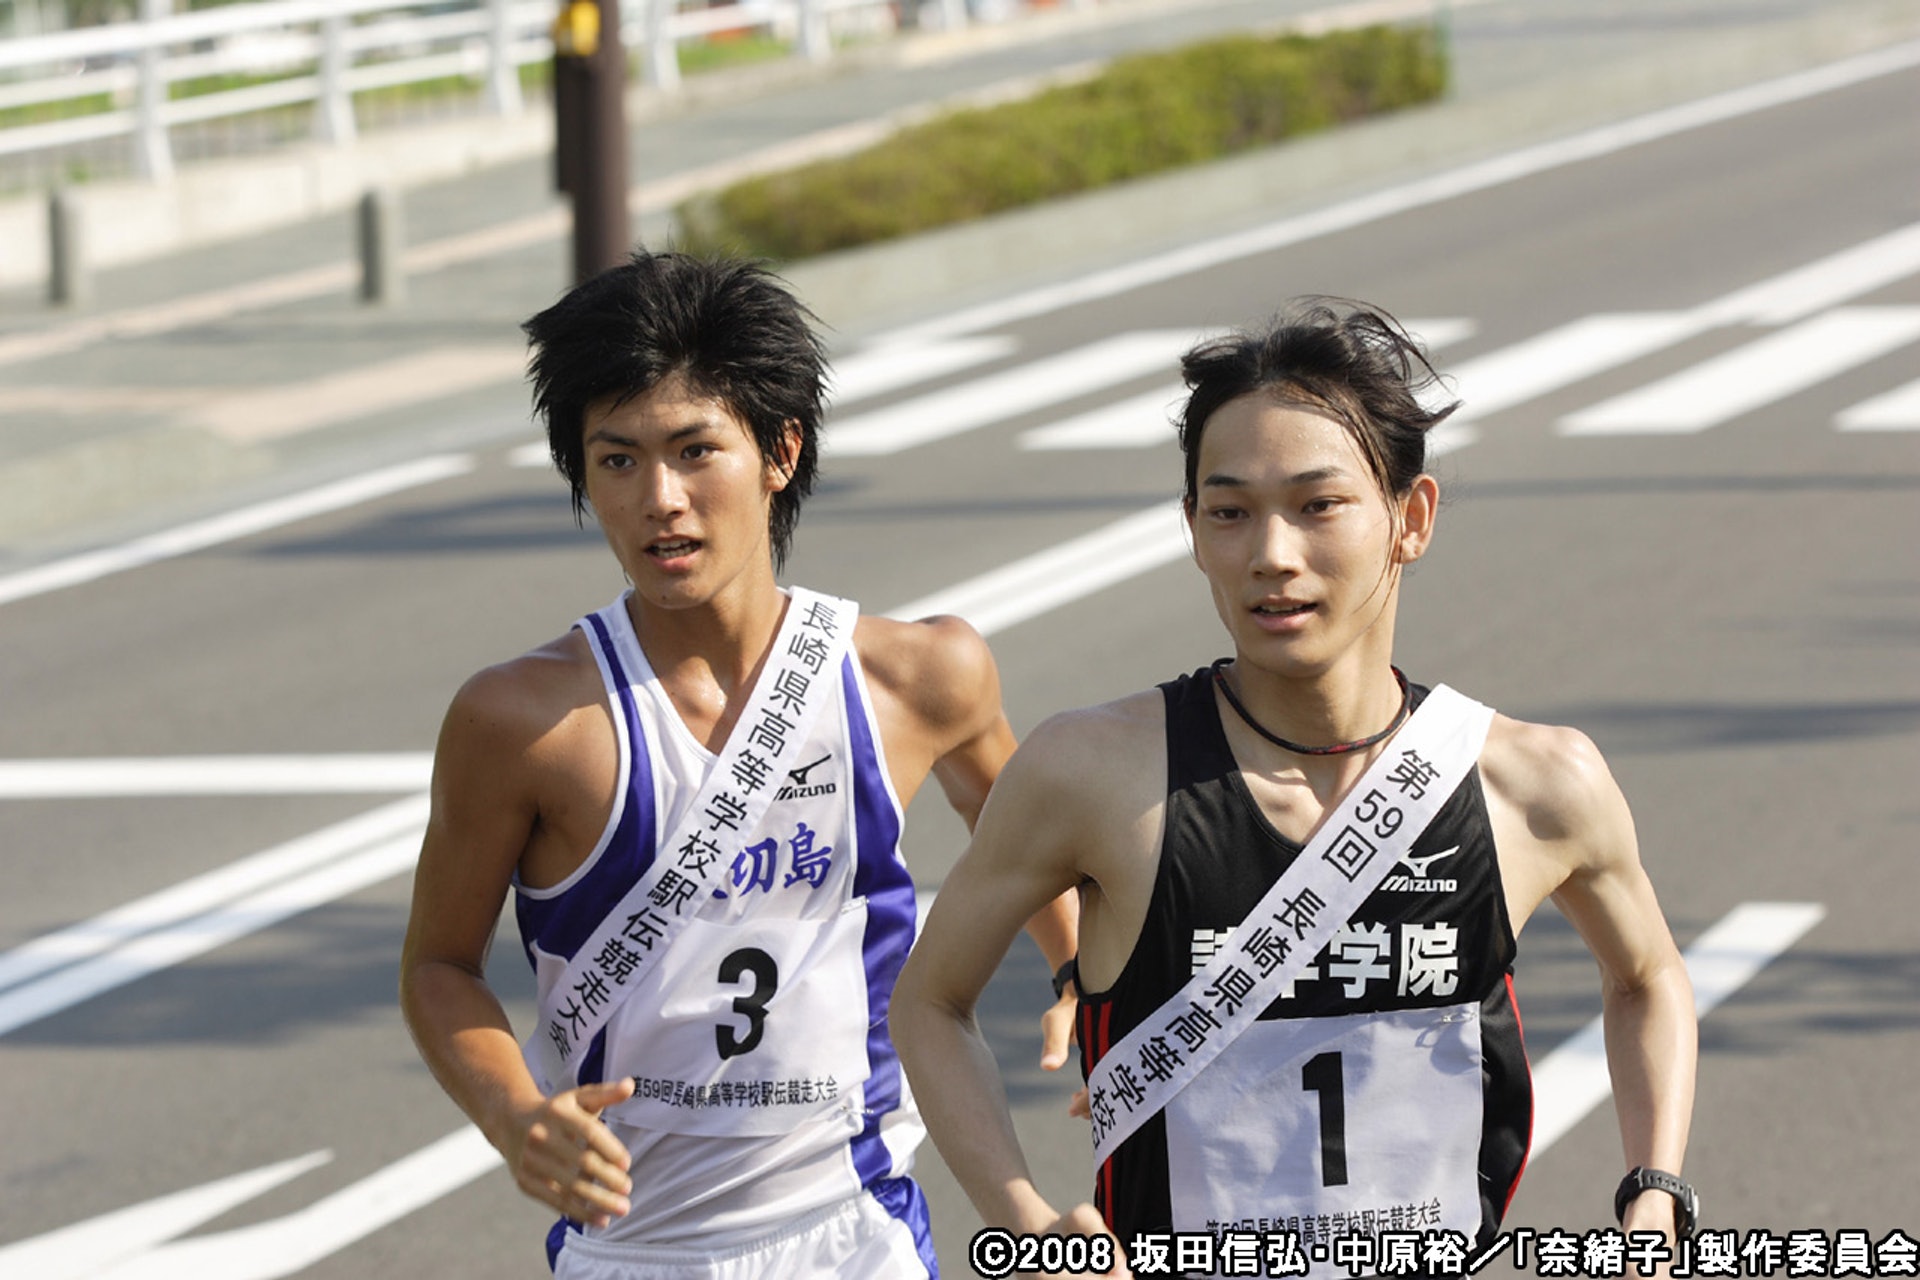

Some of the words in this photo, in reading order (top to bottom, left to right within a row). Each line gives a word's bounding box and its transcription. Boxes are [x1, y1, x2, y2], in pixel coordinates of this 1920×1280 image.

[549, 602, 838, 1061] 長崎県高等学校駅伝競走大会
[774, 783, 836, 801] MIZUNO
[712, 822, 832, 899] 切島
[1380, 875, 1457, 892] MIZUNO
[716, 947, 778, 1061] 3
[1092, 887, 1326, 1150] 長崎県高等学校
[1302, 1051, 1348, 1187] 1
